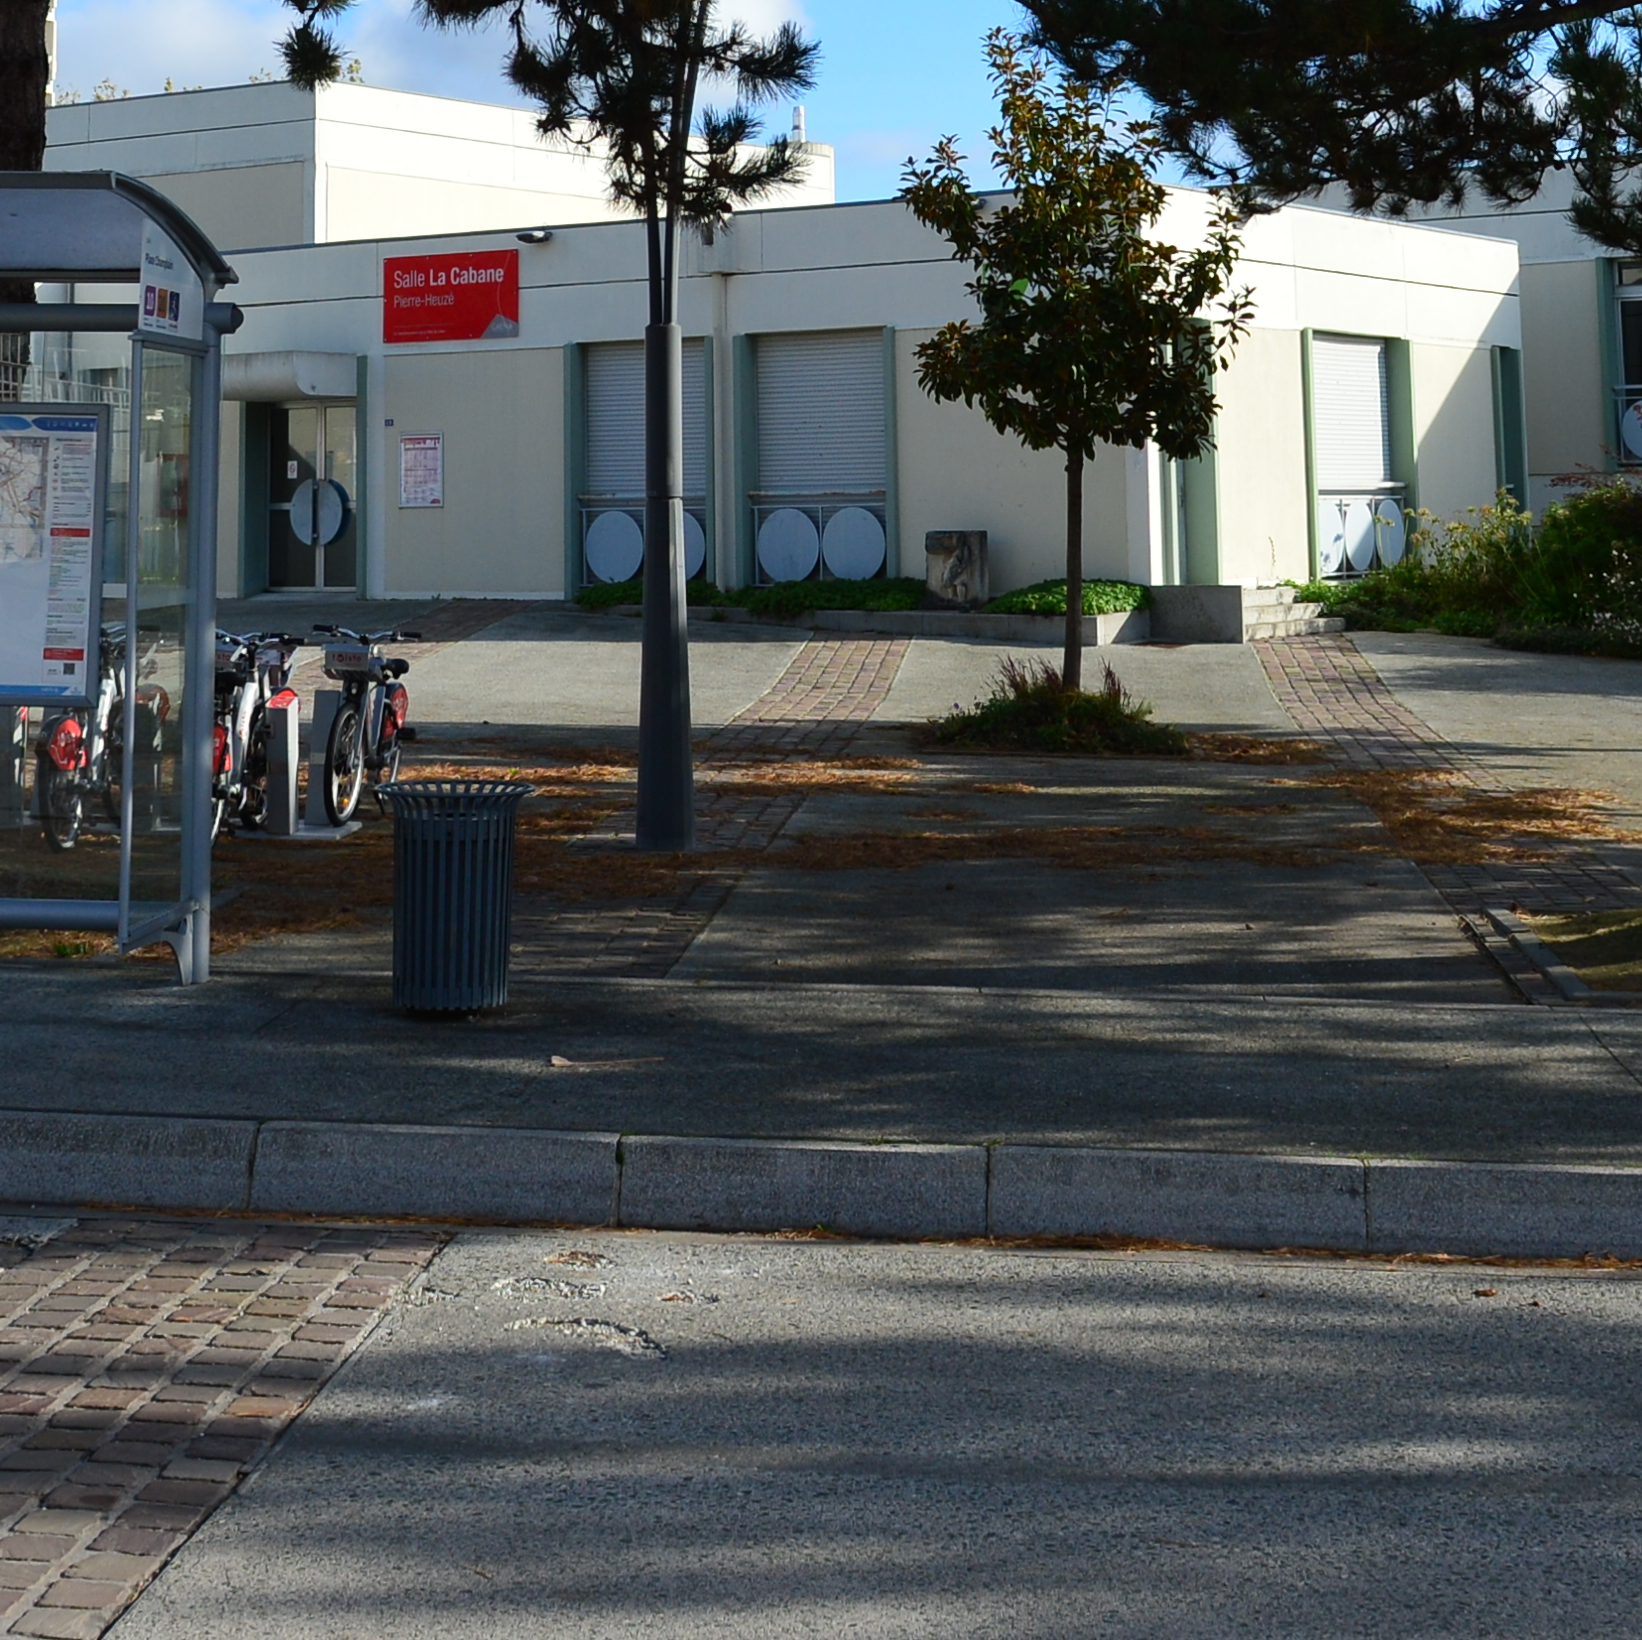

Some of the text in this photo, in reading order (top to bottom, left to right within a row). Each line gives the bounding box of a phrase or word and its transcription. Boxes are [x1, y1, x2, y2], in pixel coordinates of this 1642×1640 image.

[393, 266, 504, 289] Salle La Cabane
[393, 291, 455, 308] Pierre-Heuzé
